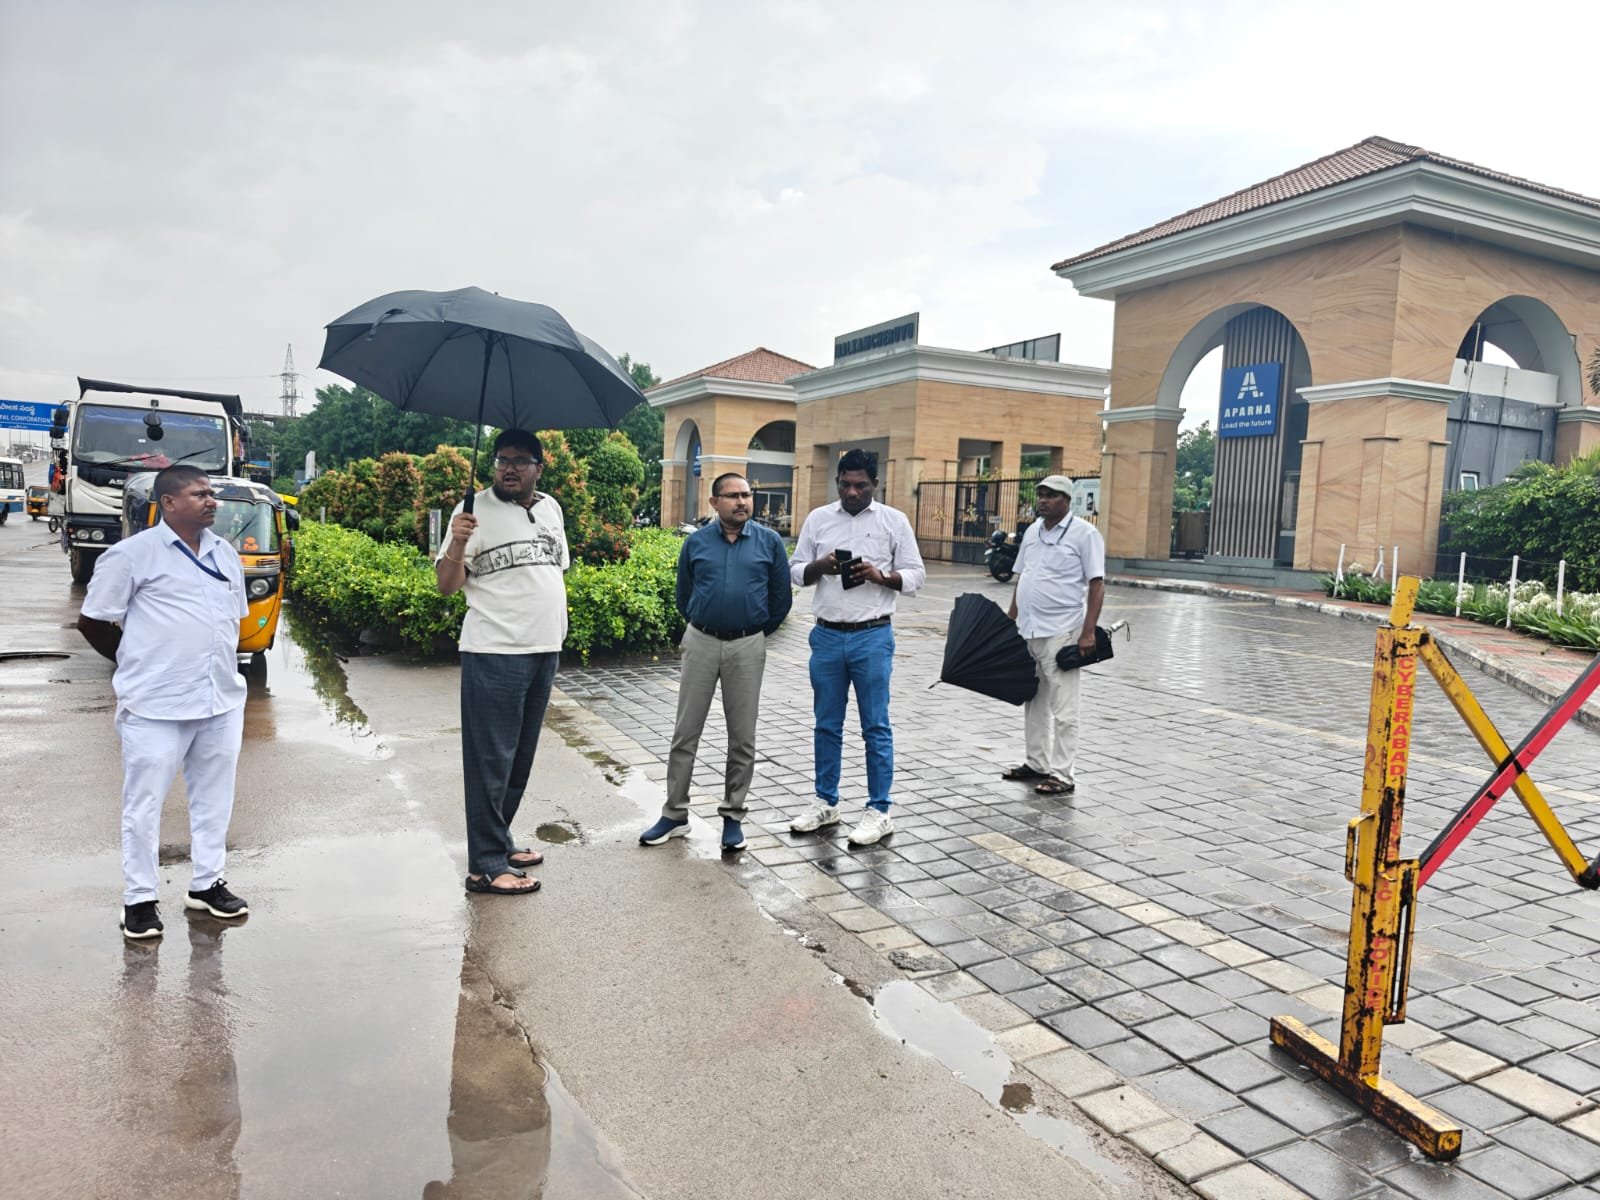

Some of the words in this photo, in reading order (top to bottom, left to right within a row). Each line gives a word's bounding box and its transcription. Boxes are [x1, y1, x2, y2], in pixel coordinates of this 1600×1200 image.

[1224, 404, 1271, 418] APARNA
[11, 415, 51, 423] CORPORATION
[1250, 419, 1272, 427] future
[1389, 656, 1414, 776] CYBERABAD
